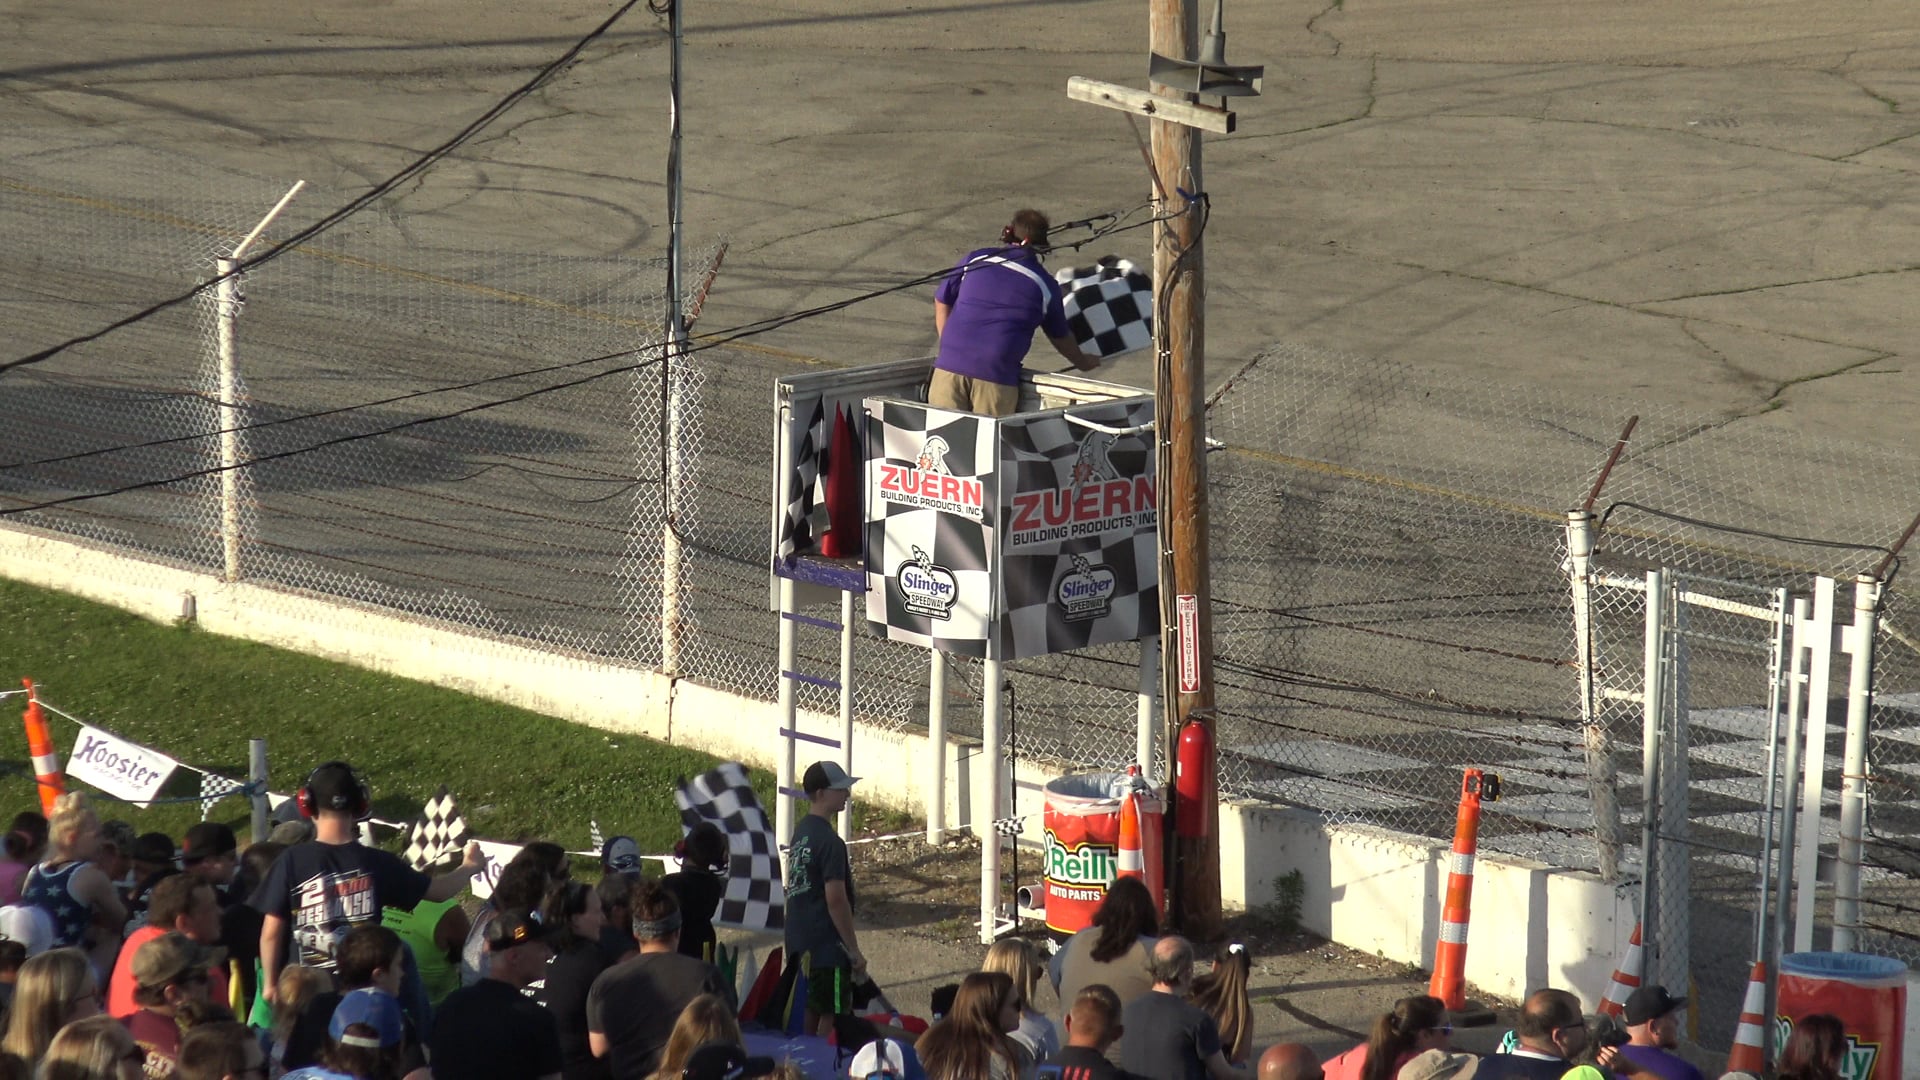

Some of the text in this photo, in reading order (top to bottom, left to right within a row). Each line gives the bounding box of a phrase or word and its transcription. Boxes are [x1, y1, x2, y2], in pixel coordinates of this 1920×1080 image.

[880, 465, 981, 507] ZUERN
[880, 490, 918, 505] BUILDING
[1012, 475, 1157, 532] ZUERN
[1013, 526, 1068, 546] BUILDING
[1071, 514, 1136, 537] PRODUCTS,
[903, 571, 952, 596] Slinger
[1062, 578, 1112, 599] Slinger
[911, 594, 944, 609] SPEEDWAY
[1069, 598, 1103, 612] SPEEDWAY
[1180, 602, 1195, 611] FIRE
[1185, 612, 1193, 685] EXTINGUISHER
[73, 735, 160, 786] Hoosier
[1049, 884, 1101, 901] AUTO PARTS
